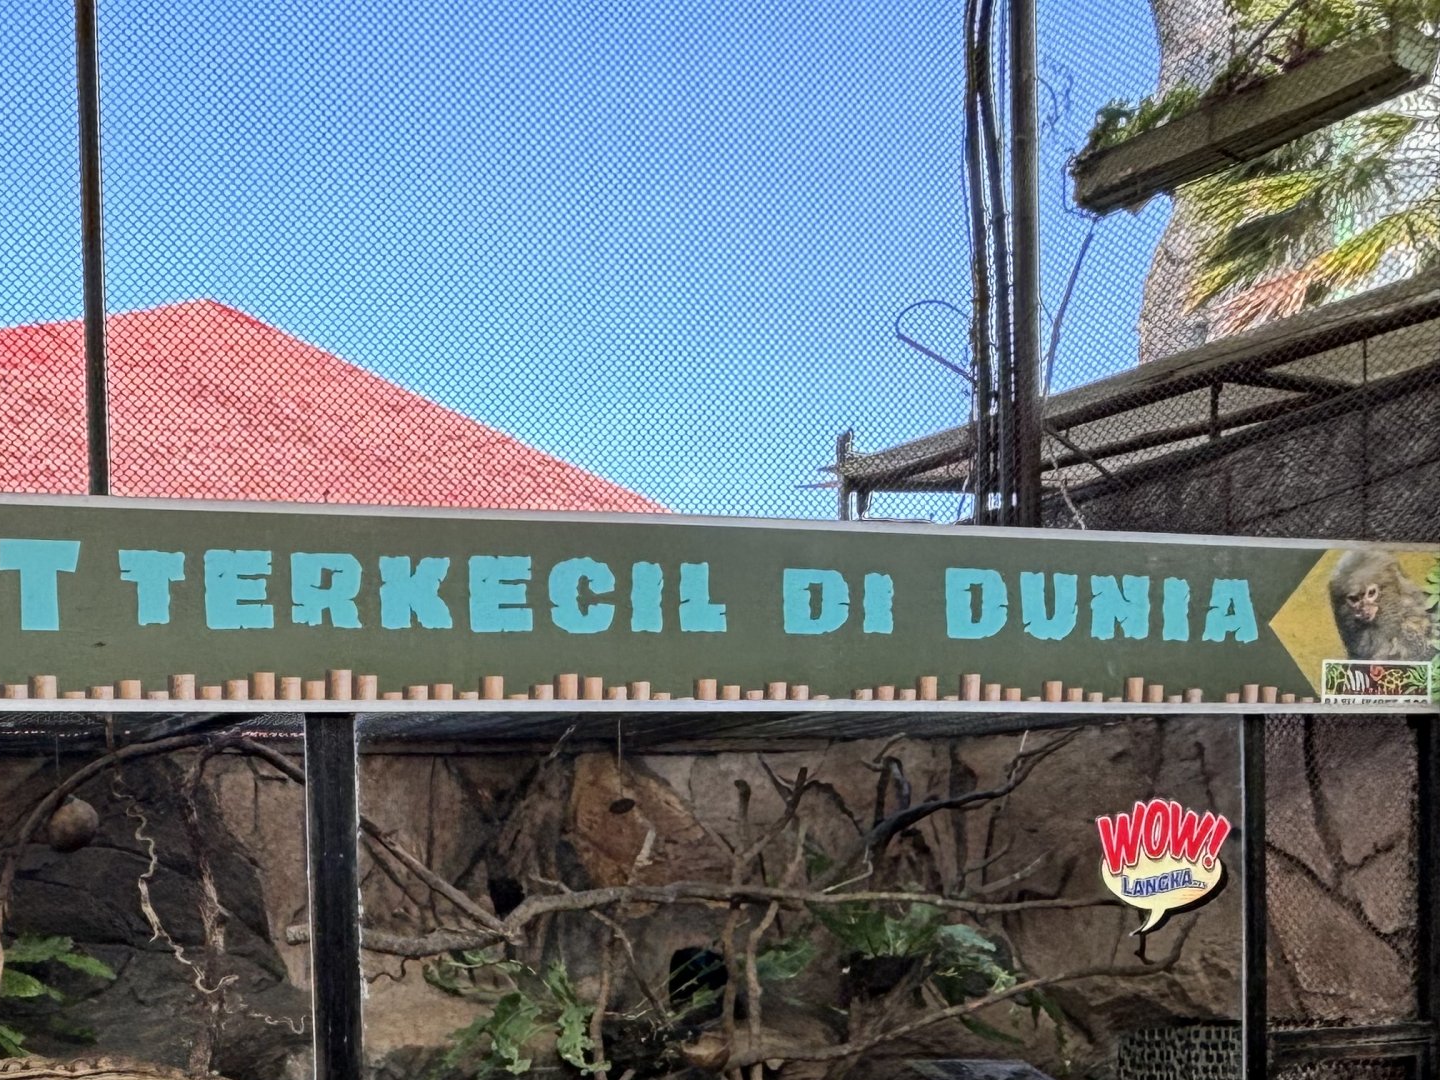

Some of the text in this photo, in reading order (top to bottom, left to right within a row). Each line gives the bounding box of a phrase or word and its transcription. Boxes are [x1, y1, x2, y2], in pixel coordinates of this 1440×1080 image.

[118, 549, 727, 634] TERKECIL
[783, 568, 894, 635] DI
[945, 567, 1259, 643] DUNIA
[1097, 799, 1232, 875] WOW!
